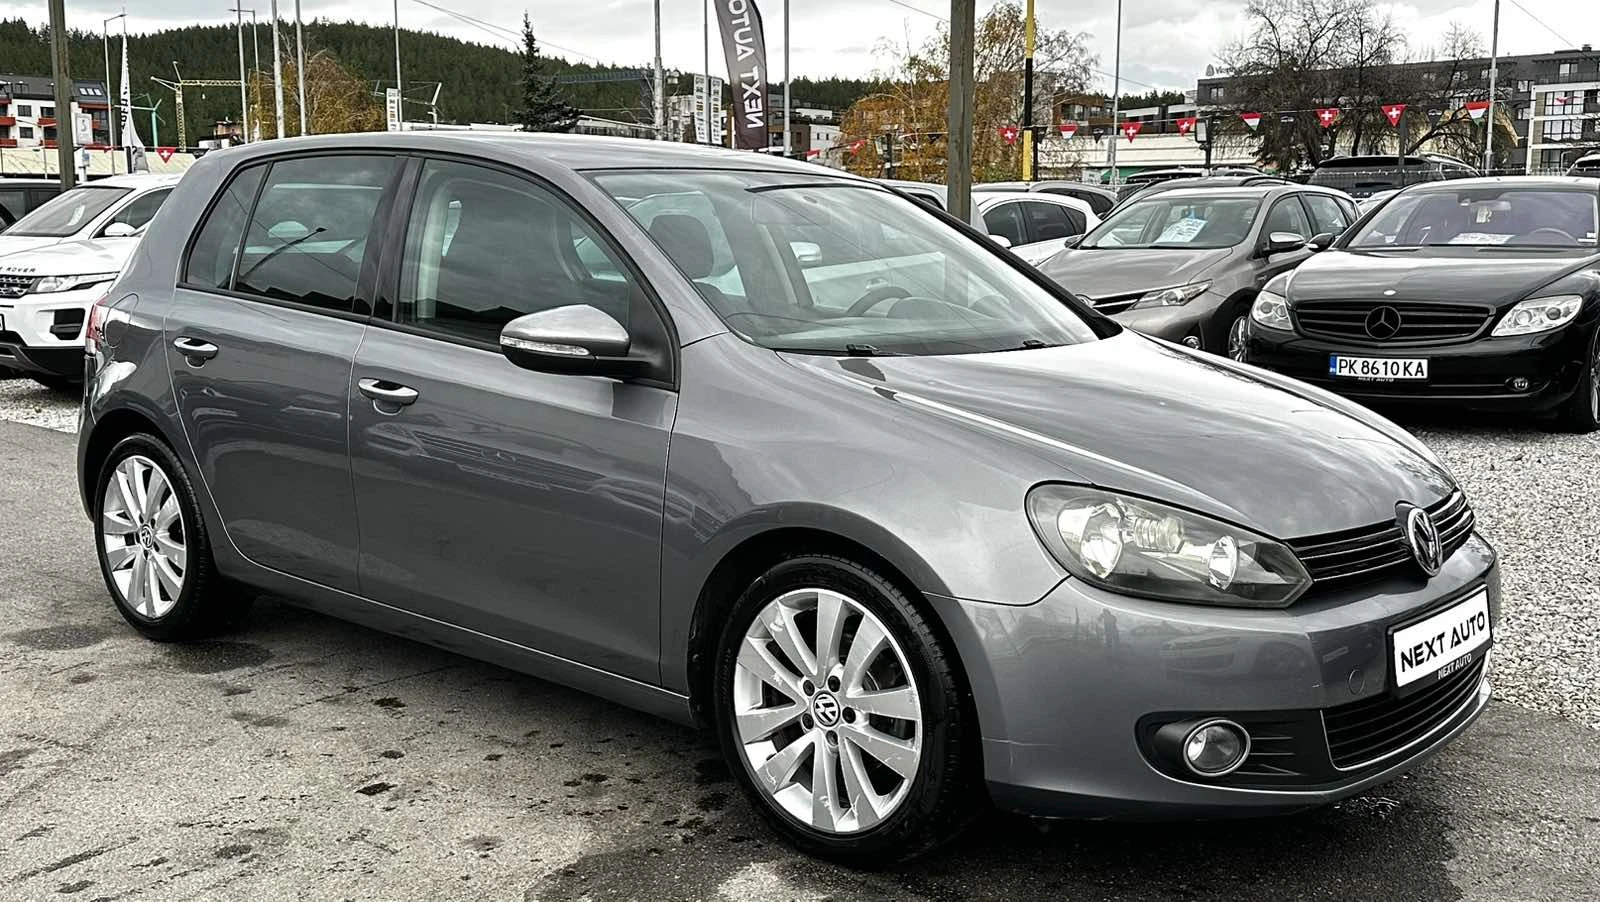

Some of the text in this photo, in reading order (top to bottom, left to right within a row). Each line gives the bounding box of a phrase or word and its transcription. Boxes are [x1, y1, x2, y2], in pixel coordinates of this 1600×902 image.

[1338, 358, 1425, 377] PK 8610 KA
[1400, 611, 1485, 673] NEXT AUTO
[1437, 653, 1472, 680] NEXT AUTO
